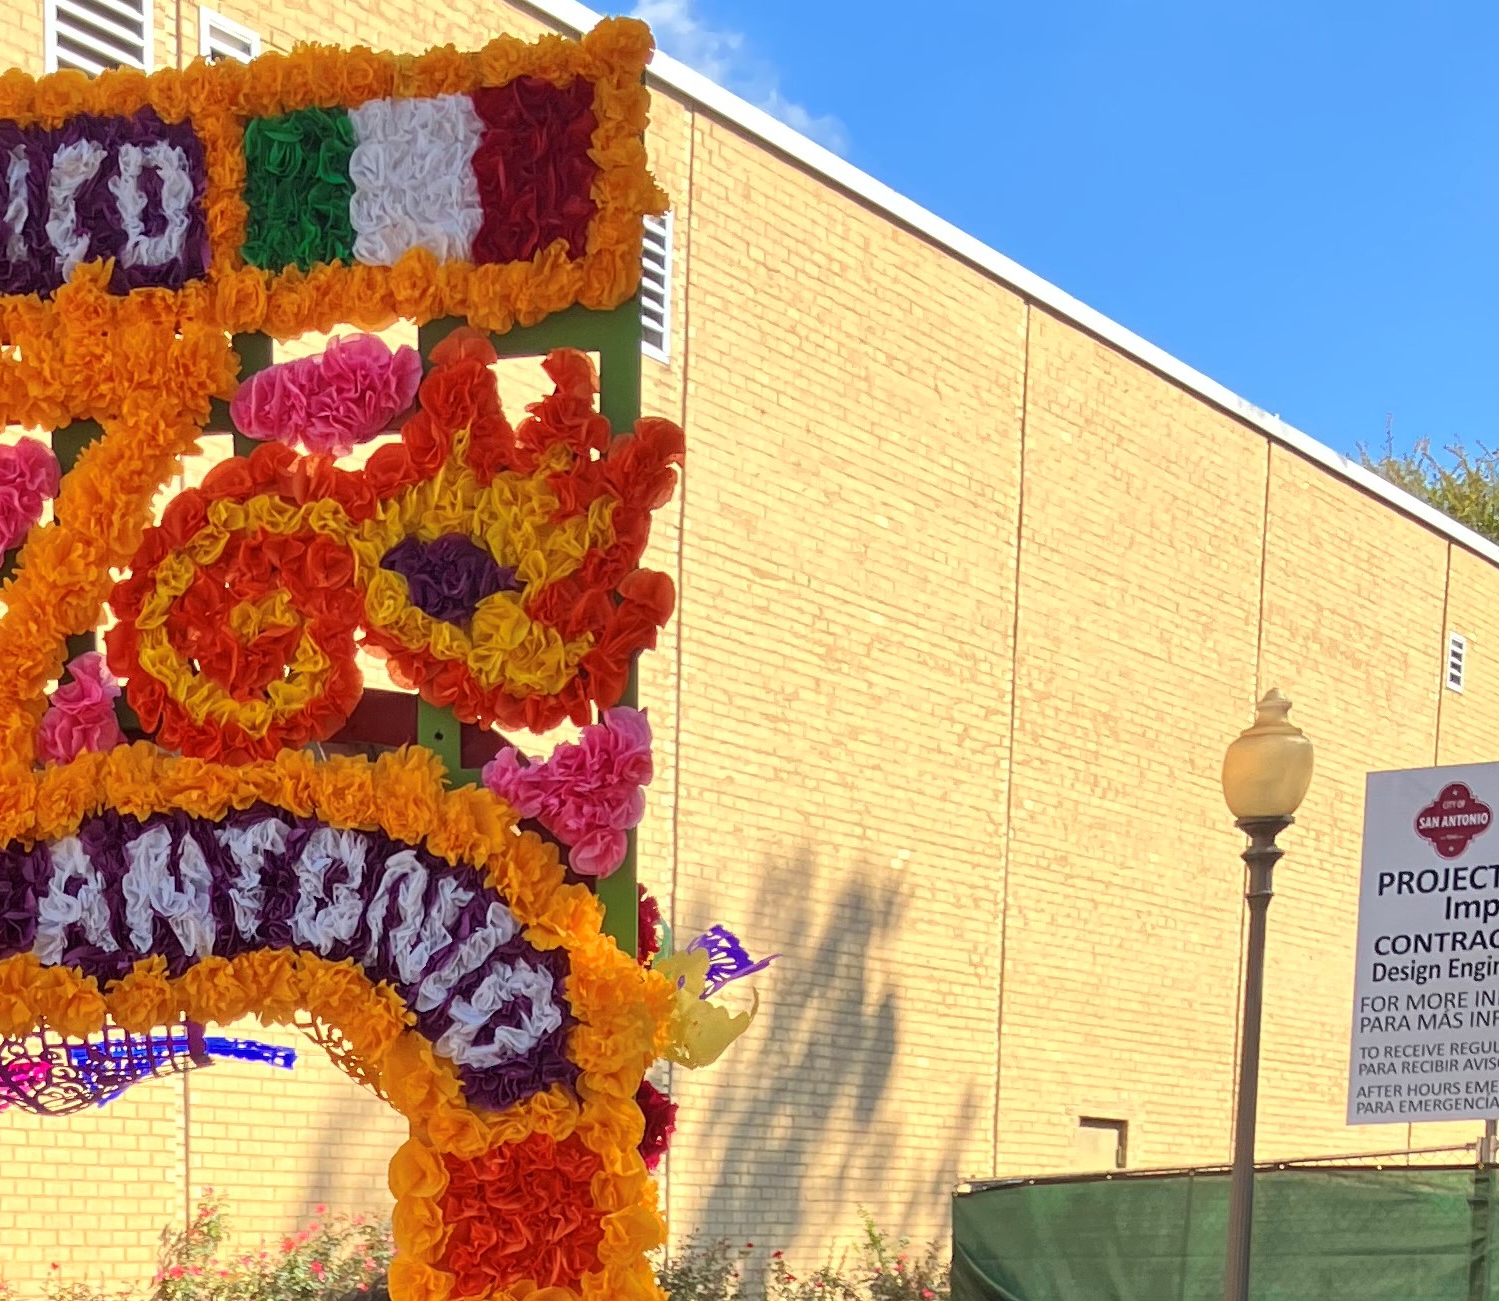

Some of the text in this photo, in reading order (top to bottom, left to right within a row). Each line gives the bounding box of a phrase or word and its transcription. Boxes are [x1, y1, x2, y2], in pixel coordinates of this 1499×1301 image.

[1457, 799, 1466, 809] OF
[1419, 812, 1489, 829] SAN ANTONIO
[1378, 864, 1499, 896] PROJECT
[32, 817, 563, 1069] ANTONIO
[1372, 959, 1440, 986] Design
[1360, 989, 1499, 1013] FOR MORE IN
[1359, 1015, 1411, 1034] PARA
[1417, 1009, 1463, 1031] MÁS
[1359, 1046, 1380, 1060] TO
[1384, 1042, 1445, 1059] RECEIVE
[1358, 1062, 1398, 1076] PARA
[1401, 1059, 1460, 1075] RECIBIR
[1356, 1084, 1403, 1099] AFTER
[1407, 1081, 1461, 1097] HOURS
[1356, 1099, 1395, 1115] PARA
